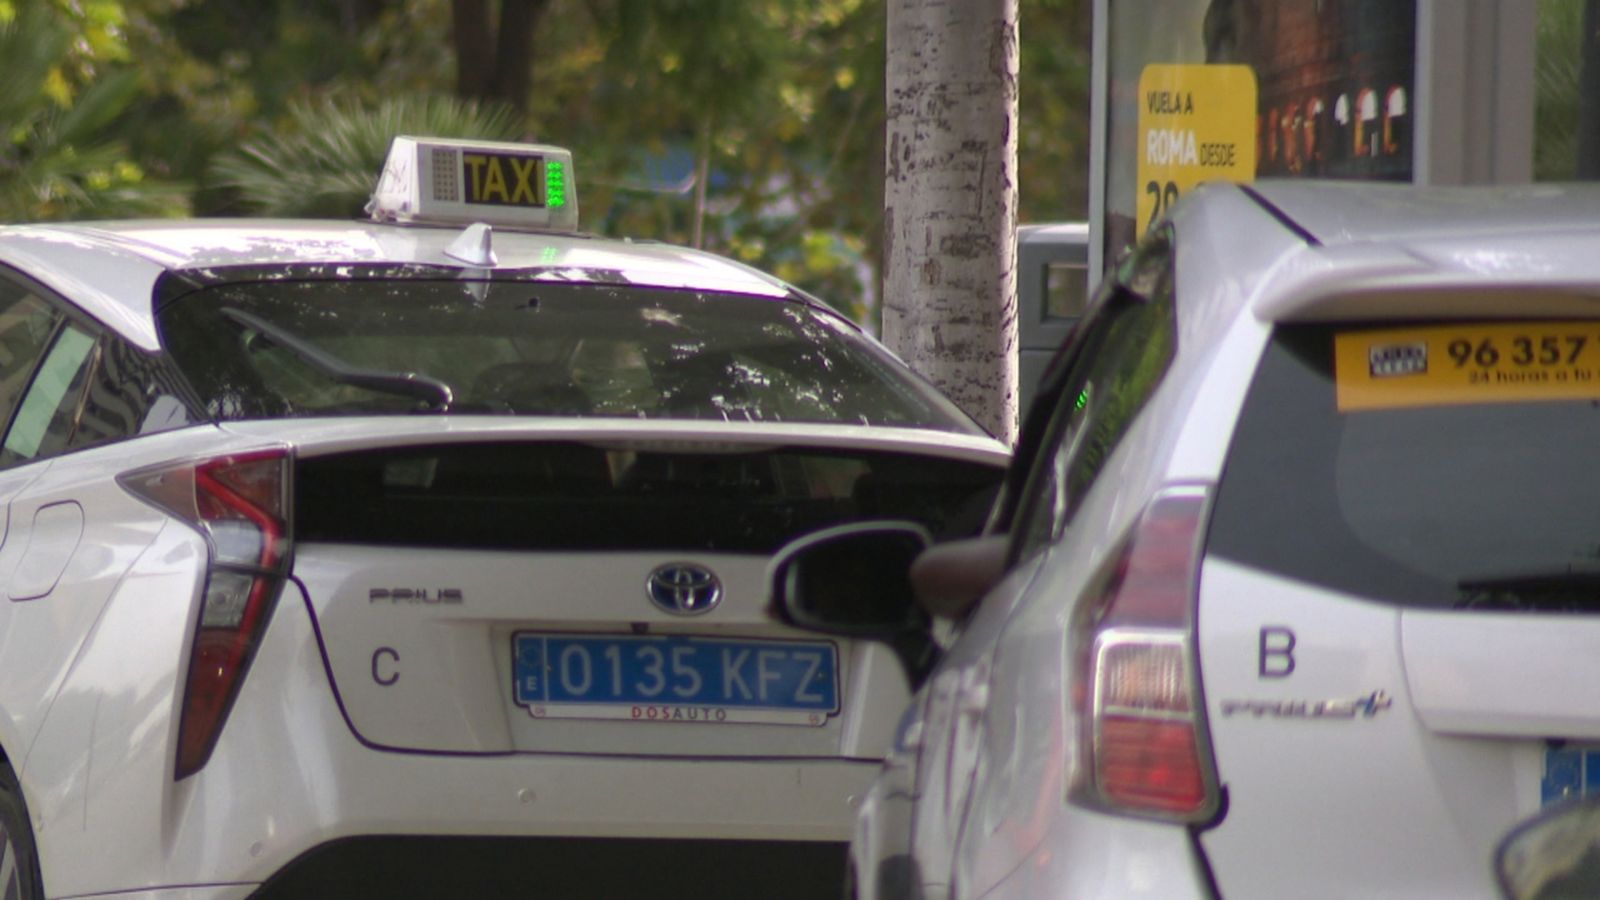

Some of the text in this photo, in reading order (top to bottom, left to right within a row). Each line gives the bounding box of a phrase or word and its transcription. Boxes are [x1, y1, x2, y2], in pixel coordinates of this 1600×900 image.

[1146, 91, 1193, 114] VUELA A
[1146, 128, 1236, 167] ROMA DESDE
[465, 155, 545, 205] TAXI
[1448, 338, 1499, 367] 96
[1512, 335, 1588, 366] 357
[1496, 369, 1549, 384] horas
[369, 588, 463, 604] PRIUS
[371, 646, 400, 686] C
[1258, 626, 1297, 679] B
[527, 676, 537, 691] E
[560, 643, 823, 703] 0135 KFZ
[632, 706, 727, 721] DOSAUTO
